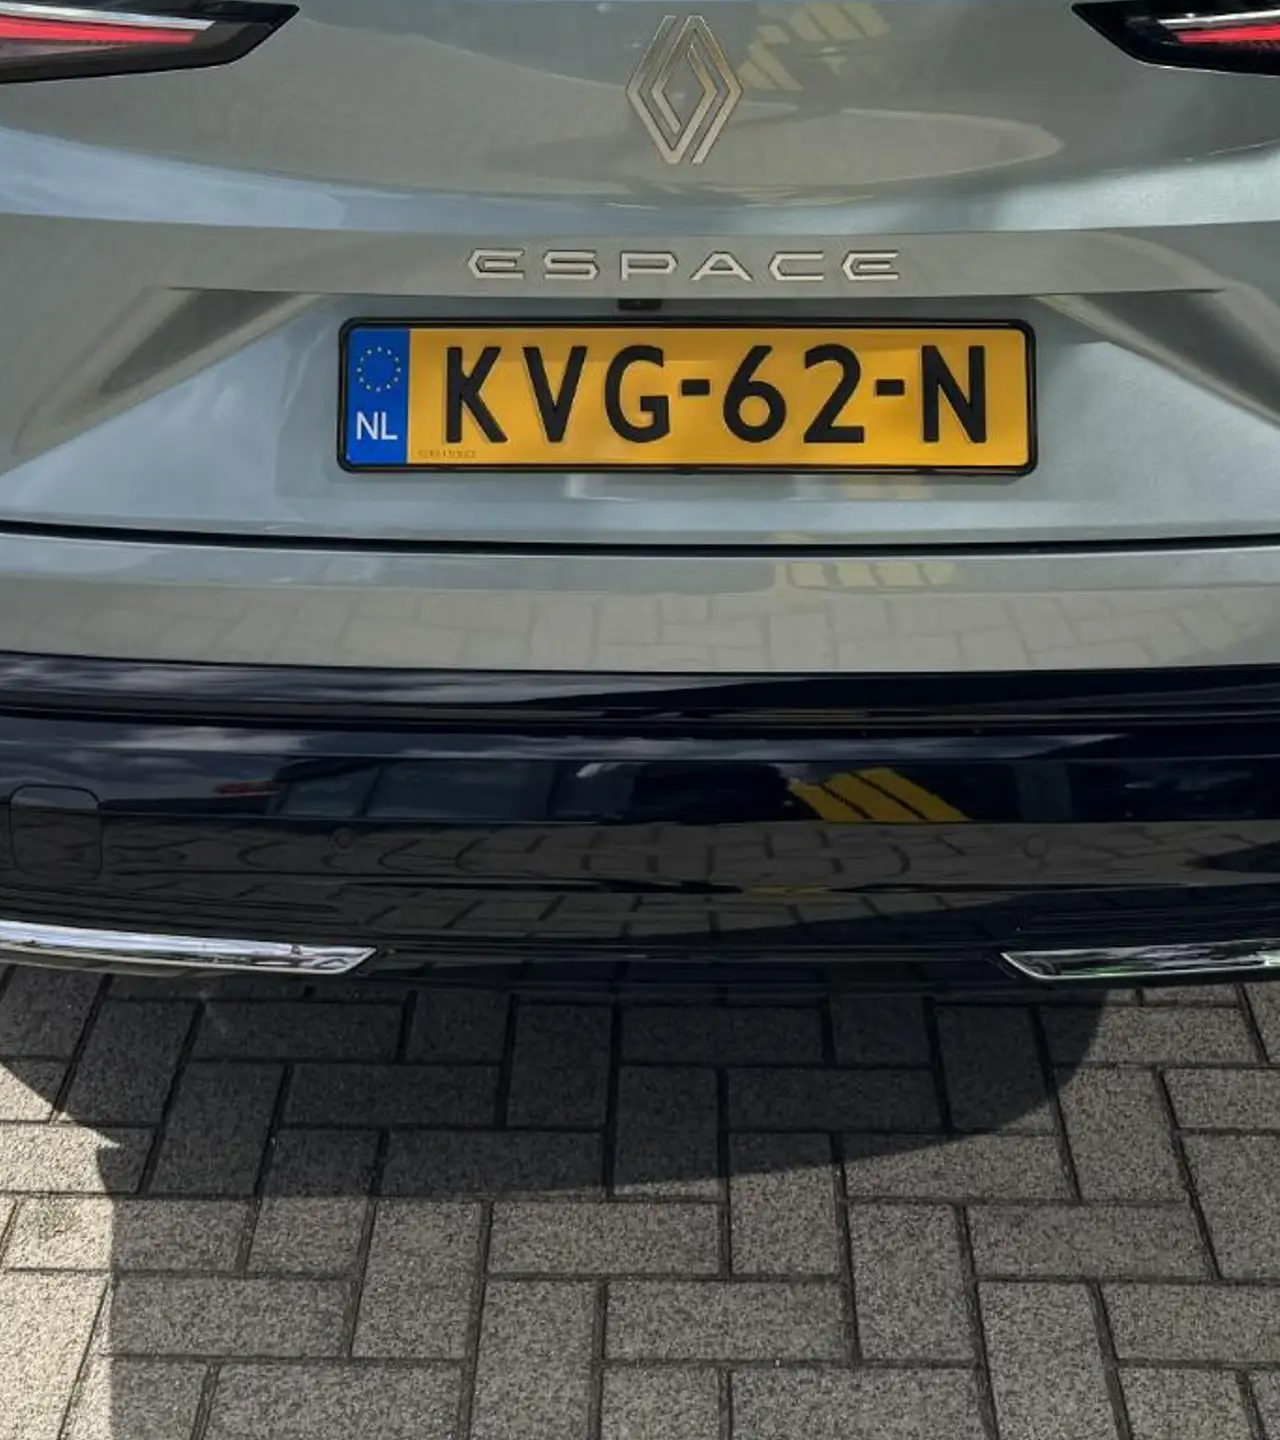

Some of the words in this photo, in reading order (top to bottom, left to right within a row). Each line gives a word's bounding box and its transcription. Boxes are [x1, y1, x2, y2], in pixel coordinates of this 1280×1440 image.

[467, 248, 901, 283] ESPACE
[444, 344, 988, 445] KVG-62-N
[356, 411, 398, 440] NL
